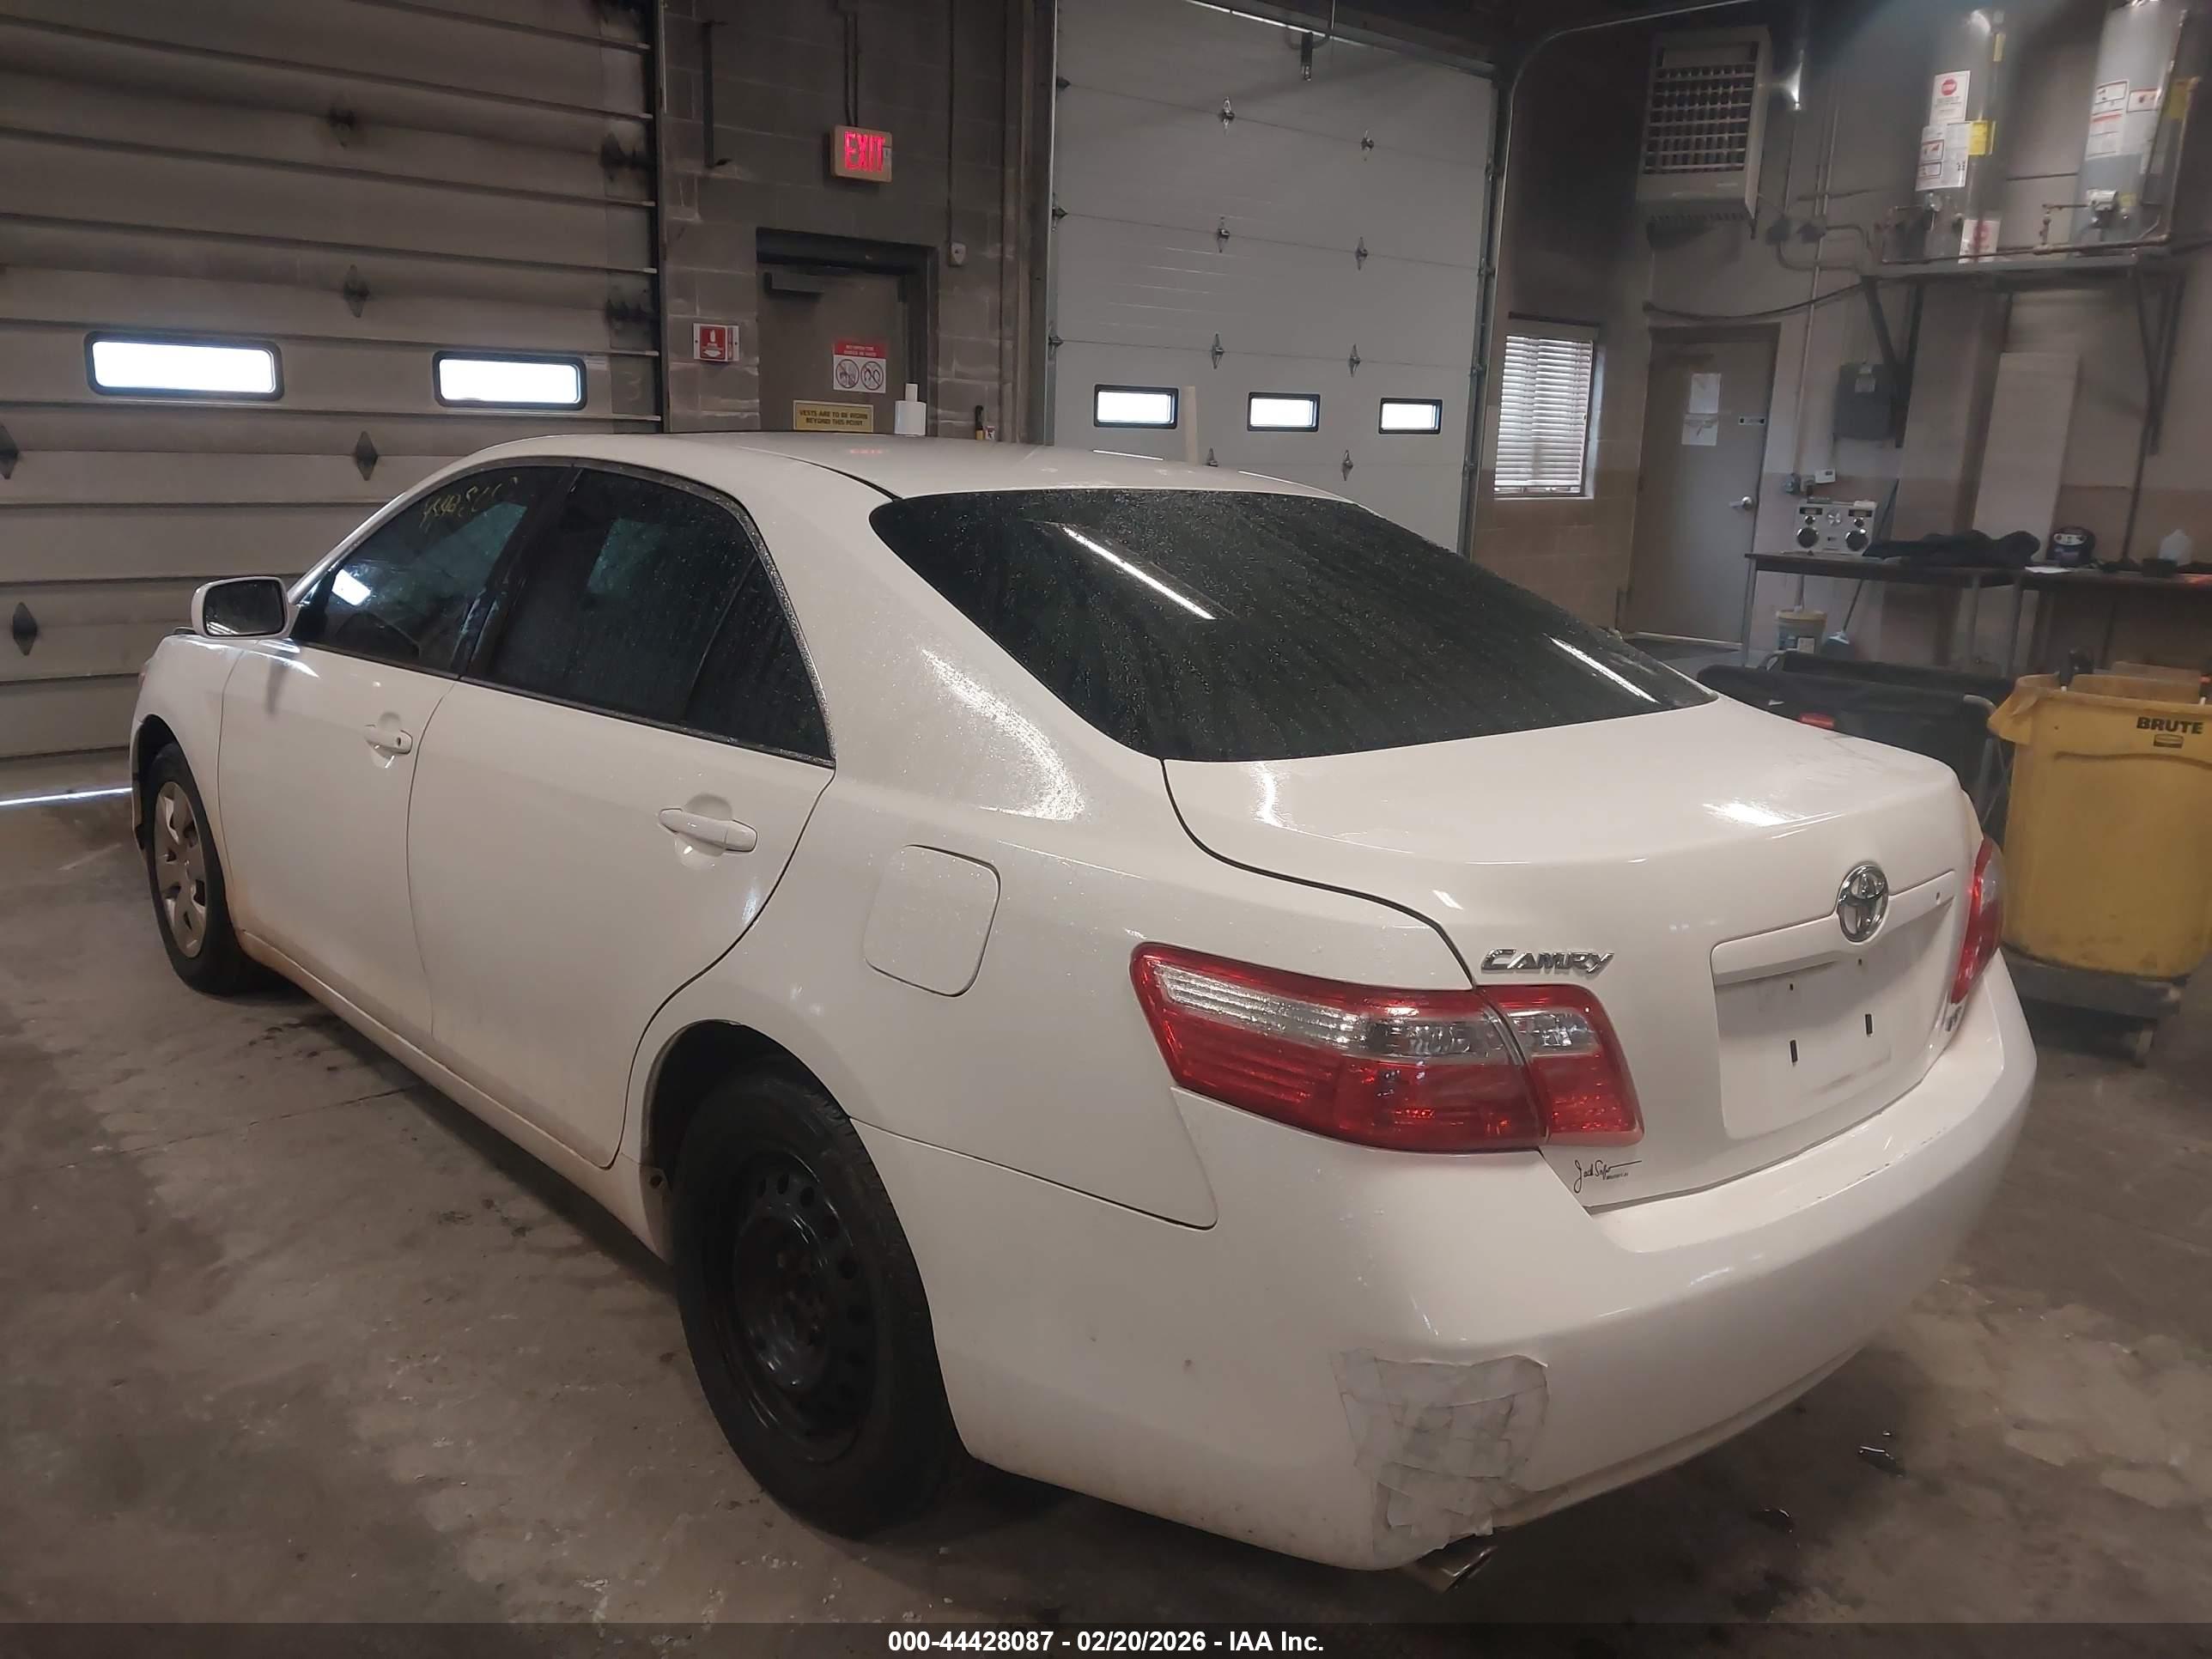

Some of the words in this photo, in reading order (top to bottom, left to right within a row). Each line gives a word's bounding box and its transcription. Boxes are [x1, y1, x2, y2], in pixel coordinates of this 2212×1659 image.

[845, 131, 885, 172] EXIT
[2136, 716, 2204, 734] BRUTE
[1481, 948, 1614, 975] CAMRY
